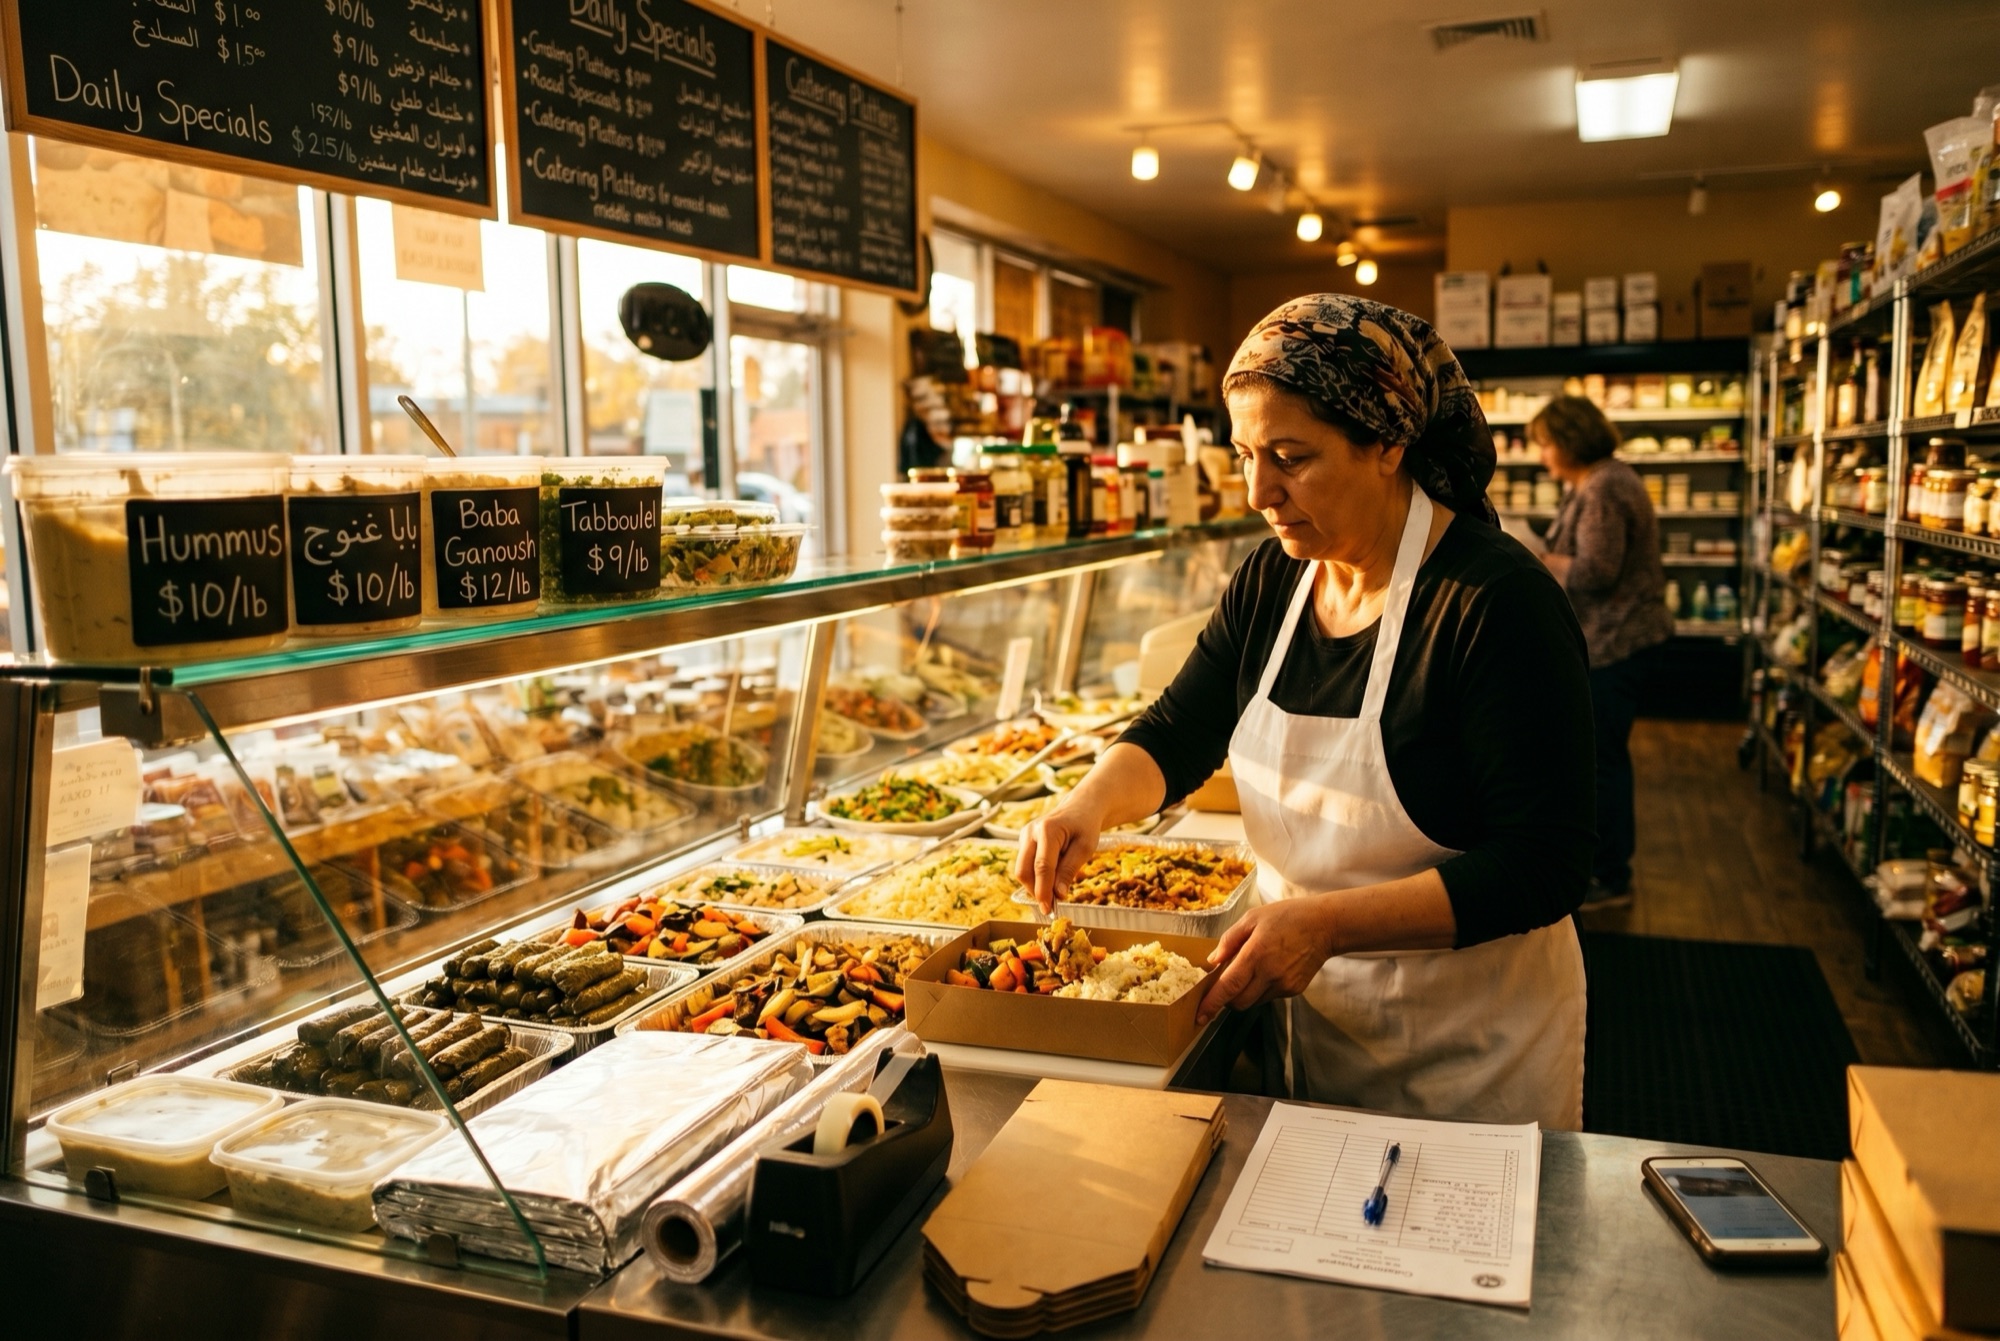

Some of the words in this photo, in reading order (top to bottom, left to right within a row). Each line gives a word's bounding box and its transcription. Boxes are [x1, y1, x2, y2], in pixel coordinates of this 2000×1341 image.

[332, 30, 379, 67] $9/lb
[569, 0, 628, 55] Daily
[637, 0, 717, 67] Specials
[50, 54, 143, 133] Daily
[157, 79, 272, 145] Specials
[338, 70, 382, 105] $9/lb
[531, 100, 586, 148] Catering
[588, 115, 634, 151] Platters
[533, 148, 600, 201] Catering
[602, 164, 656, 202] Platters
[389, 505, 417, 550] بابا
[459, 498, 520, 529] Baba
[138, 514, 283, 564] Hummus
[303, 513, 383, 566] غنوج
[444, 530, 536, 567] Ganoush
[587, 540, 649, 580] $9/lb
[158, 575, 268, 627] $10/lb
[327, 562, 415, 607] $10/lb
[459, 567, 531, 603] $12/lb
